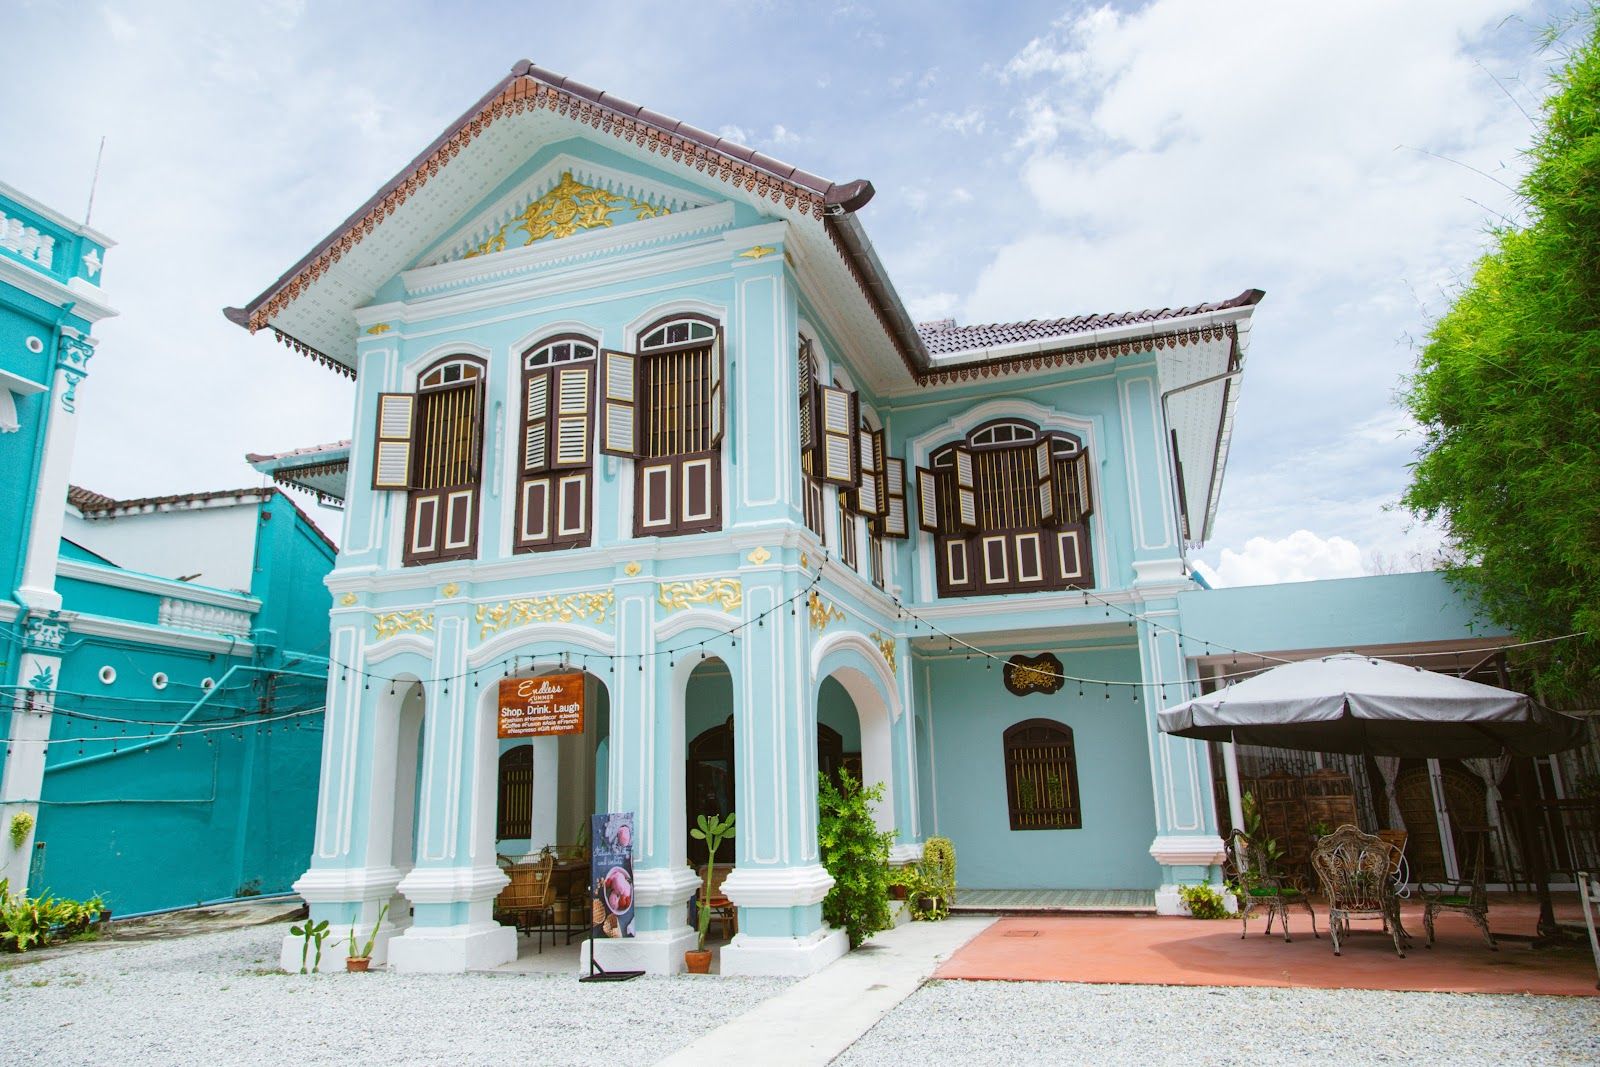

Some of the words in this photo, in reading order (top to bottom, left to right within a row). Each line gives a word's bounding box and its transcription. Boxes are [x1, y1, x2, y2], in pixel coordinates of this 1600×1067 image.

[518, 680, 563, 697] Endless
[528, 694, 554, 704] SUMMER
[501, 708, 524, 717] Shop.
[527, 705, 551, 715] Drink.
[554, 702, 580, 713] Laugh
